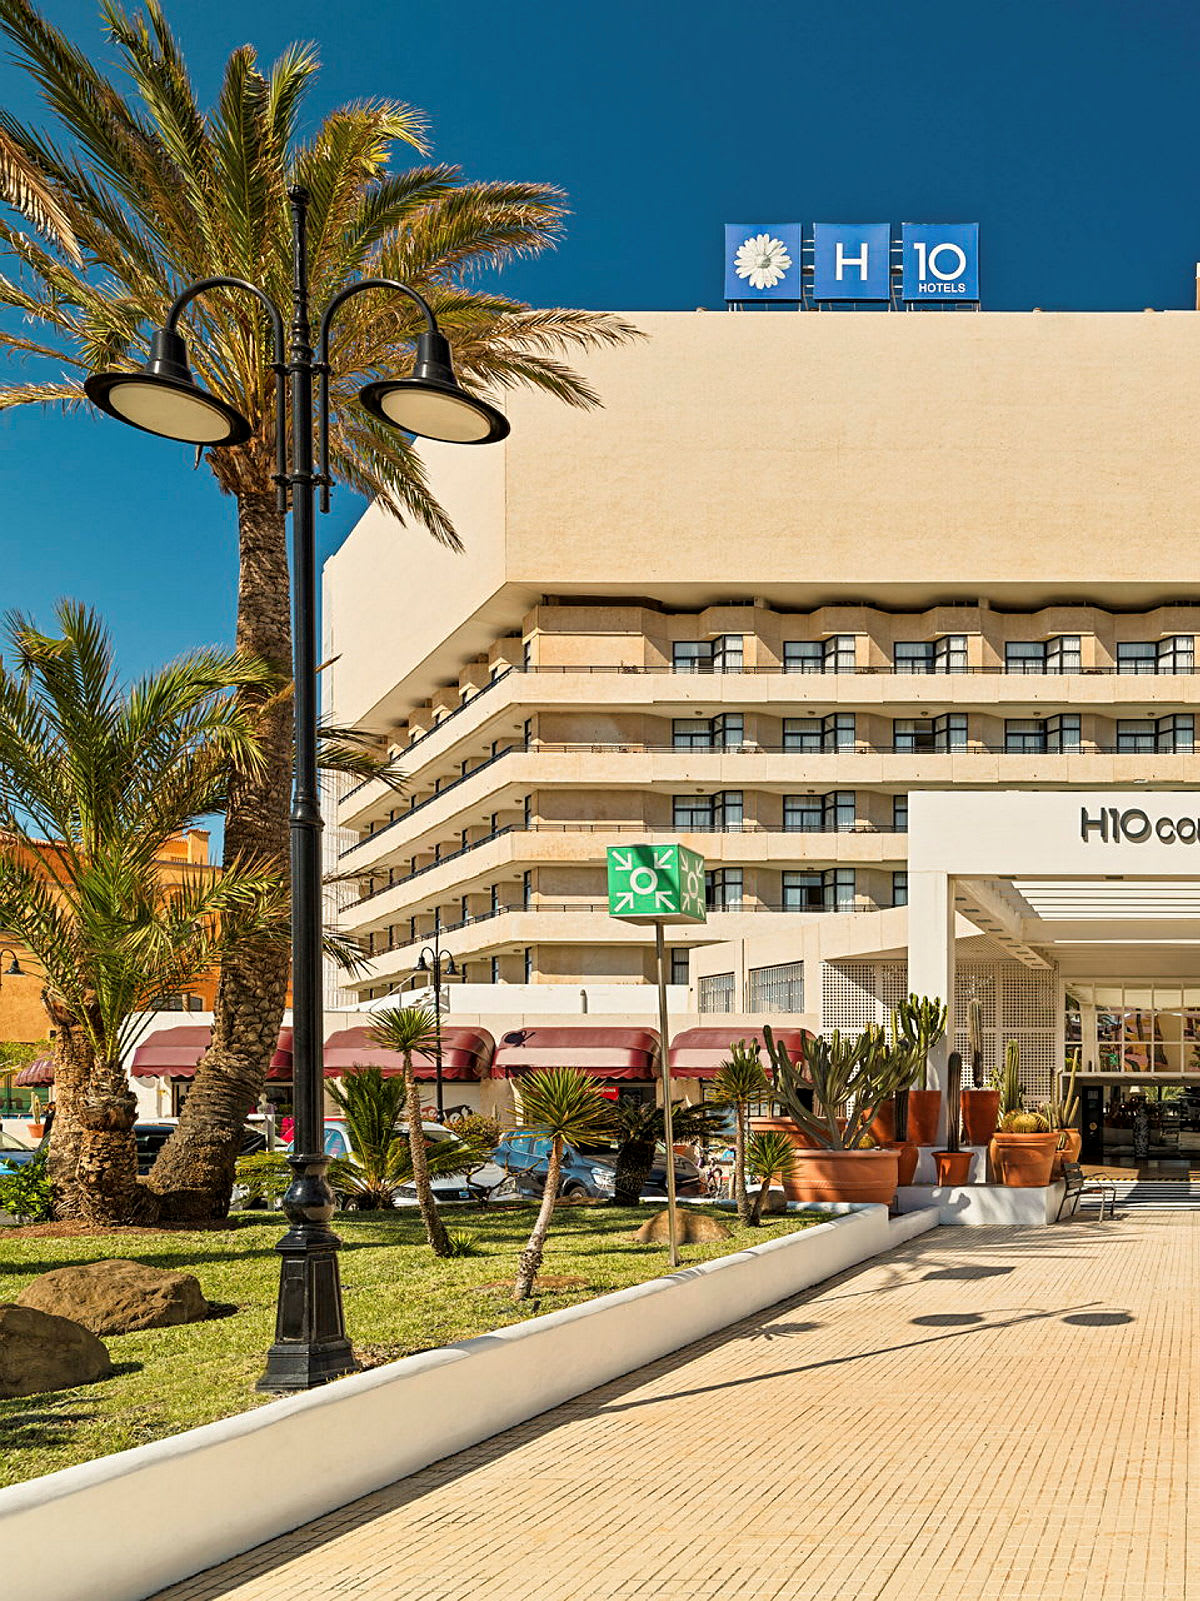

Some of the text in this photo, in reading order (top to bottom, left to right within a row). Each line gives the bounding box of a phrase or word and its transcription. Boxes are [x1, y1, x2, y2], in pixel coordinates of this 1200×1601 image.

[835, 242, 967, 281] H 10
[918, 283, 966, 294] HOTELS
